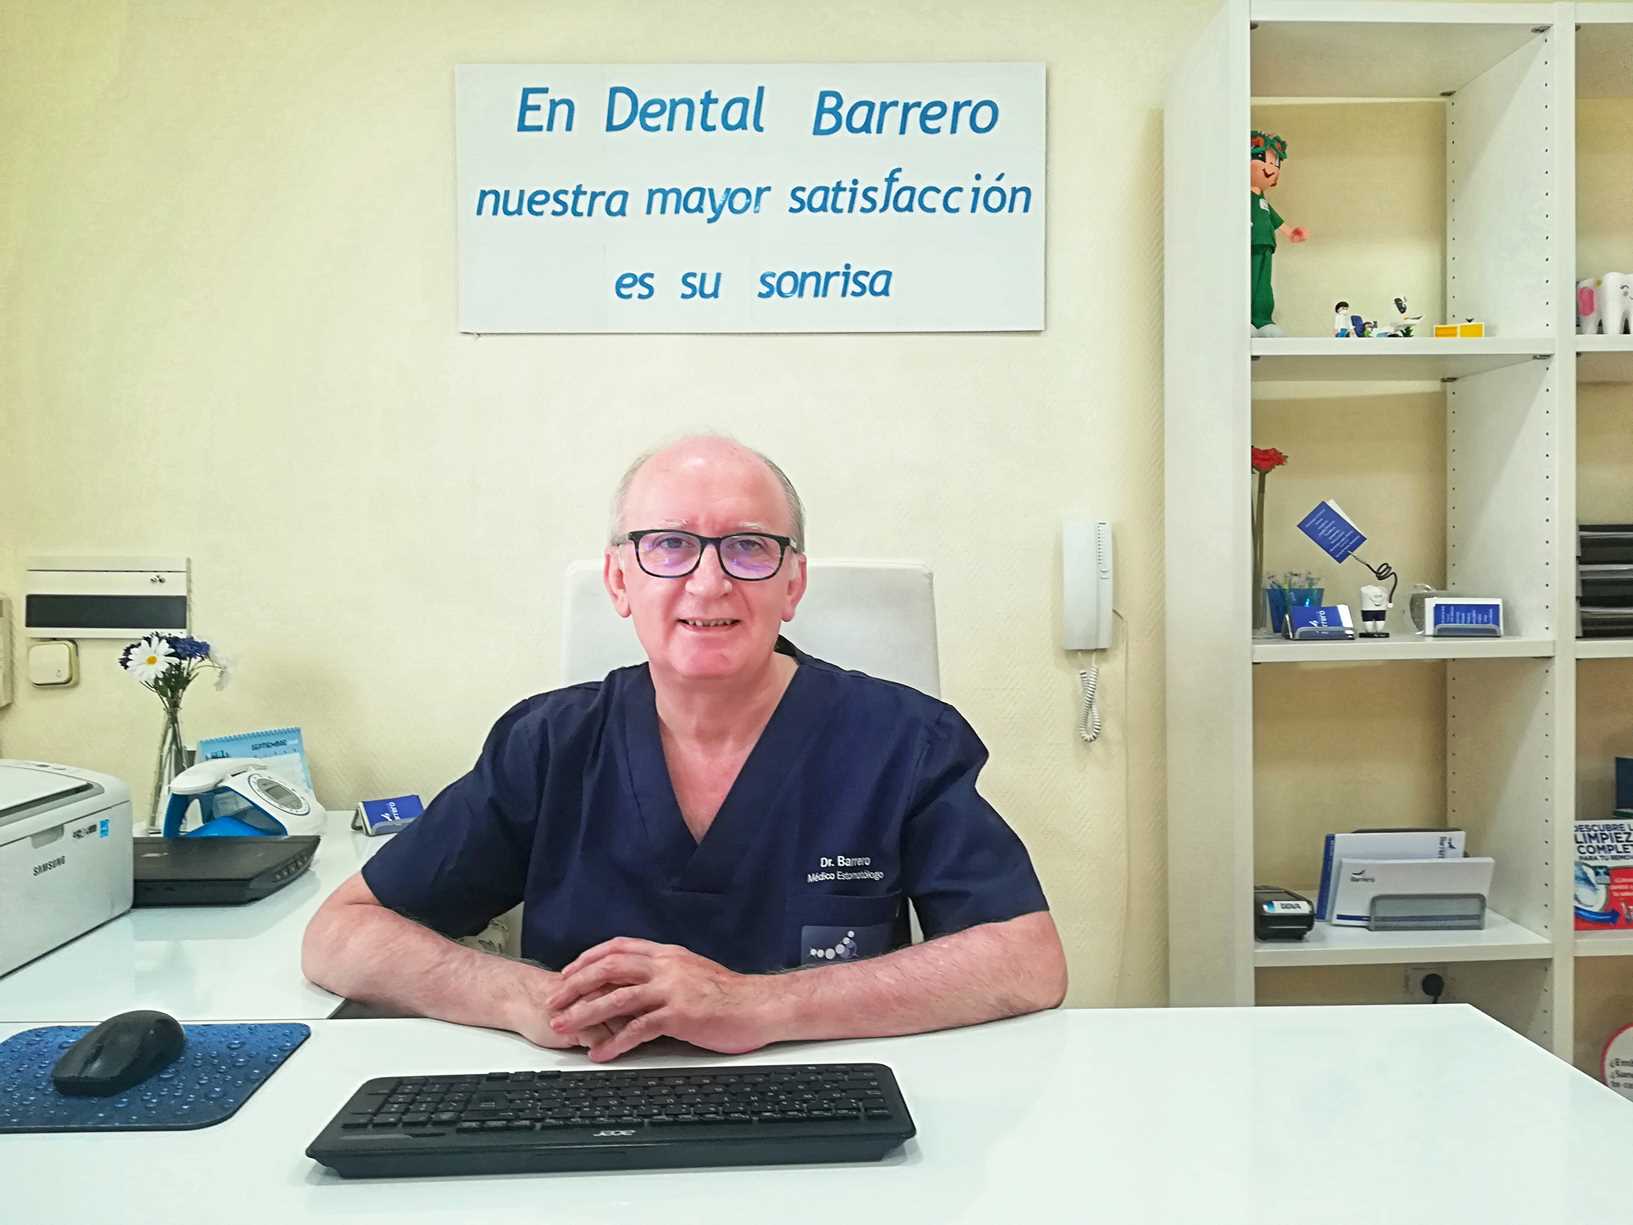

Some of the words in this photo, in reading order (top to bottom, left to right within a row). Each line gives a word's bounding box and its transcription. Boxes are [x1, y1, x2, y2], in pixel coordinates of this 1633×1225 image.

[517, 86, 575, 132] En
[606, 86, 765, 132] Dental
[812, 90, 999, 136] Barrero
[476, 184, 629, 217] nuestra
[646, 183, 771, 224] mayor
[789, 167, 1032, 214] satisfacción
[614, 271, 655, 300] es
[680, 271, 721, 300] su
[758, 263, 893, 299] sonrisa
[33, 856, 66, 877] SAMSUNG
[820, 856, 835, 868] Dr.
[837, 855, 871, 867] Barrero
[807, 871, 836, 883] Médico
